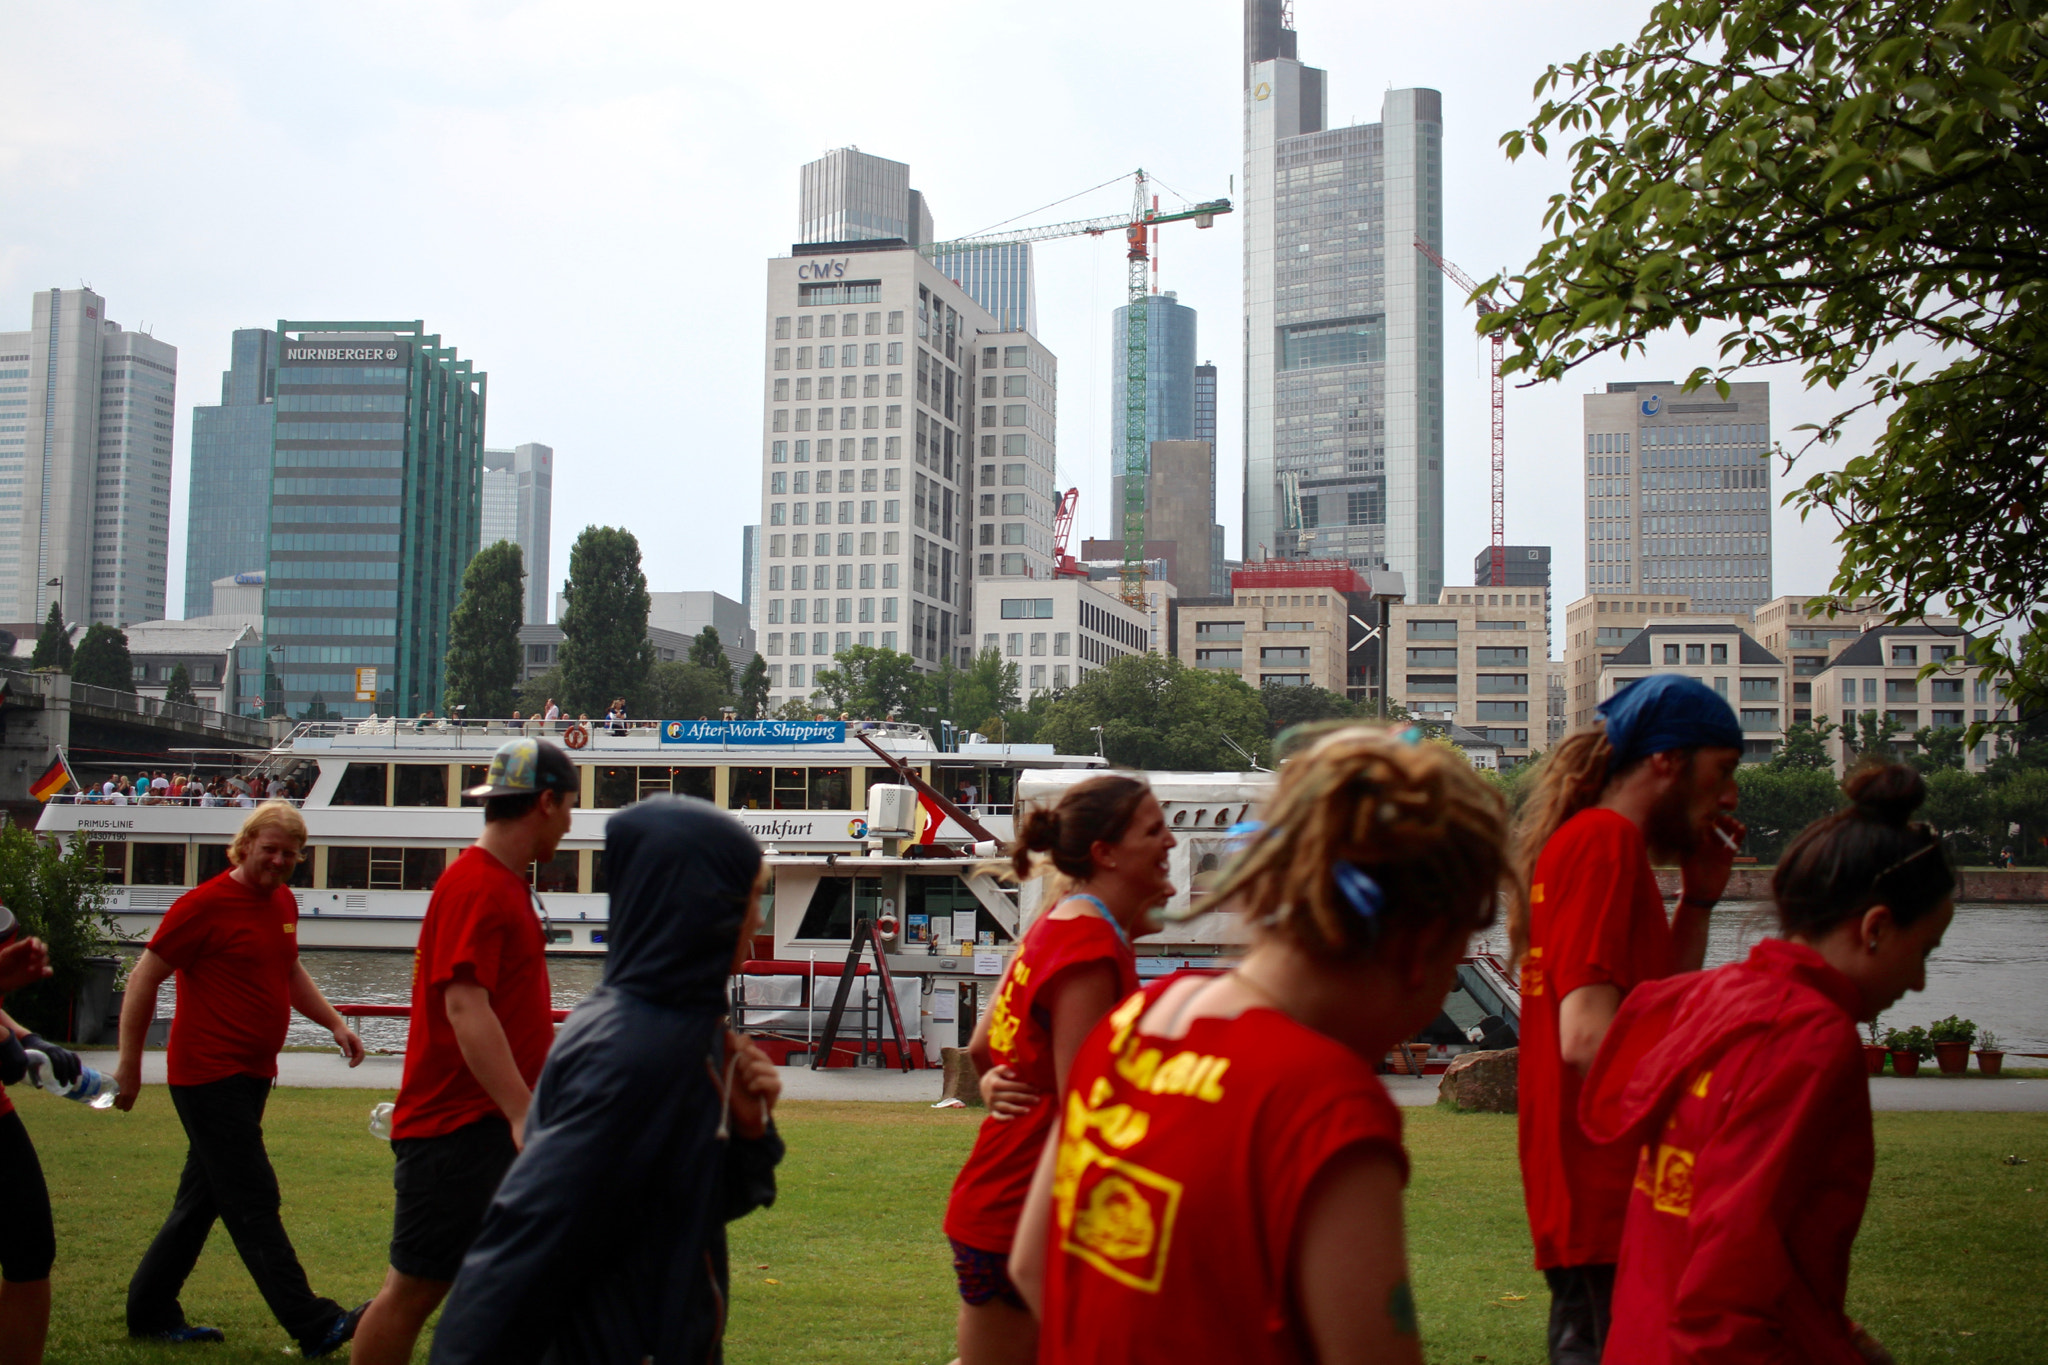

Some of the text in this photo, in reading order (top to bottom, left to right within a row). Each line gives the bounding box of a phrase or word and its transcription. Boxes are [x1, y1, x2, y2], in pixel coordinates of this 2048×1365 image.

[687, 722, 836, 741] After-Work-Shipping
[78, 820, 134, 828] PRIMUS-LINIE
[741, 820, 813, 840] rankfurt
